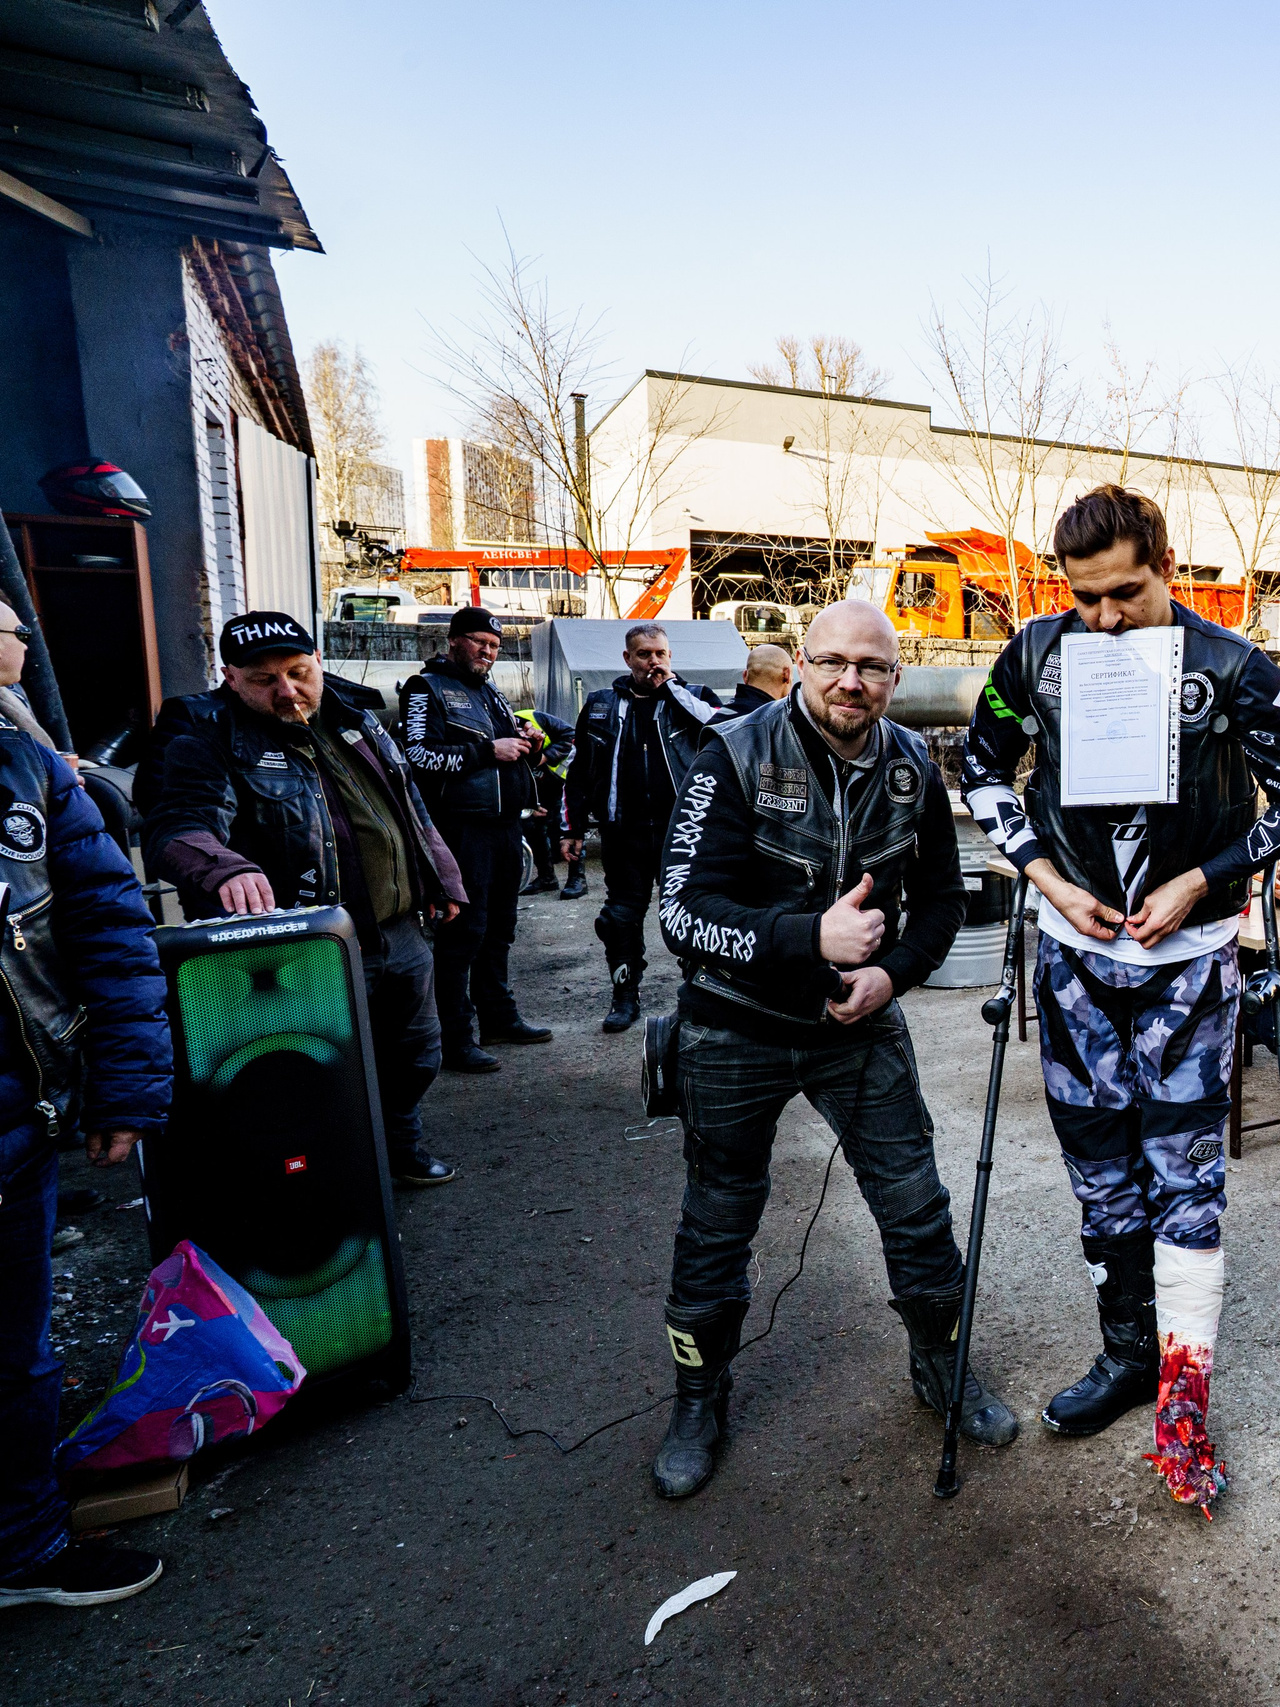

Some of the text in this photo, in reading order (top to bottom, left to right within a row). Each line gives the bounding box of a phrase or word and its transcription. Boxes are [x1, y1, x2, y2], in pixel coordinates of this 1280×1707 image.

[482, 550, 541, 559] ЛЕНСВЕТ
[231, 622, 299, 645] THMC
[1091, 670, 1136, 679] СЕРТИФИКАТ
[407, 693, 429, 741] NORMANS
[445, 754, 464, 772] MC
[760, 794, 805, 811] PRESIDENT
[669, 773, 718, 858] SUPPORT
[1, 846, 15, 858] THE
[295, 868, 317, 909] IA
[692, 917, 757, 962] RIDERS
[289, 1160, 304, 1170] JBL
